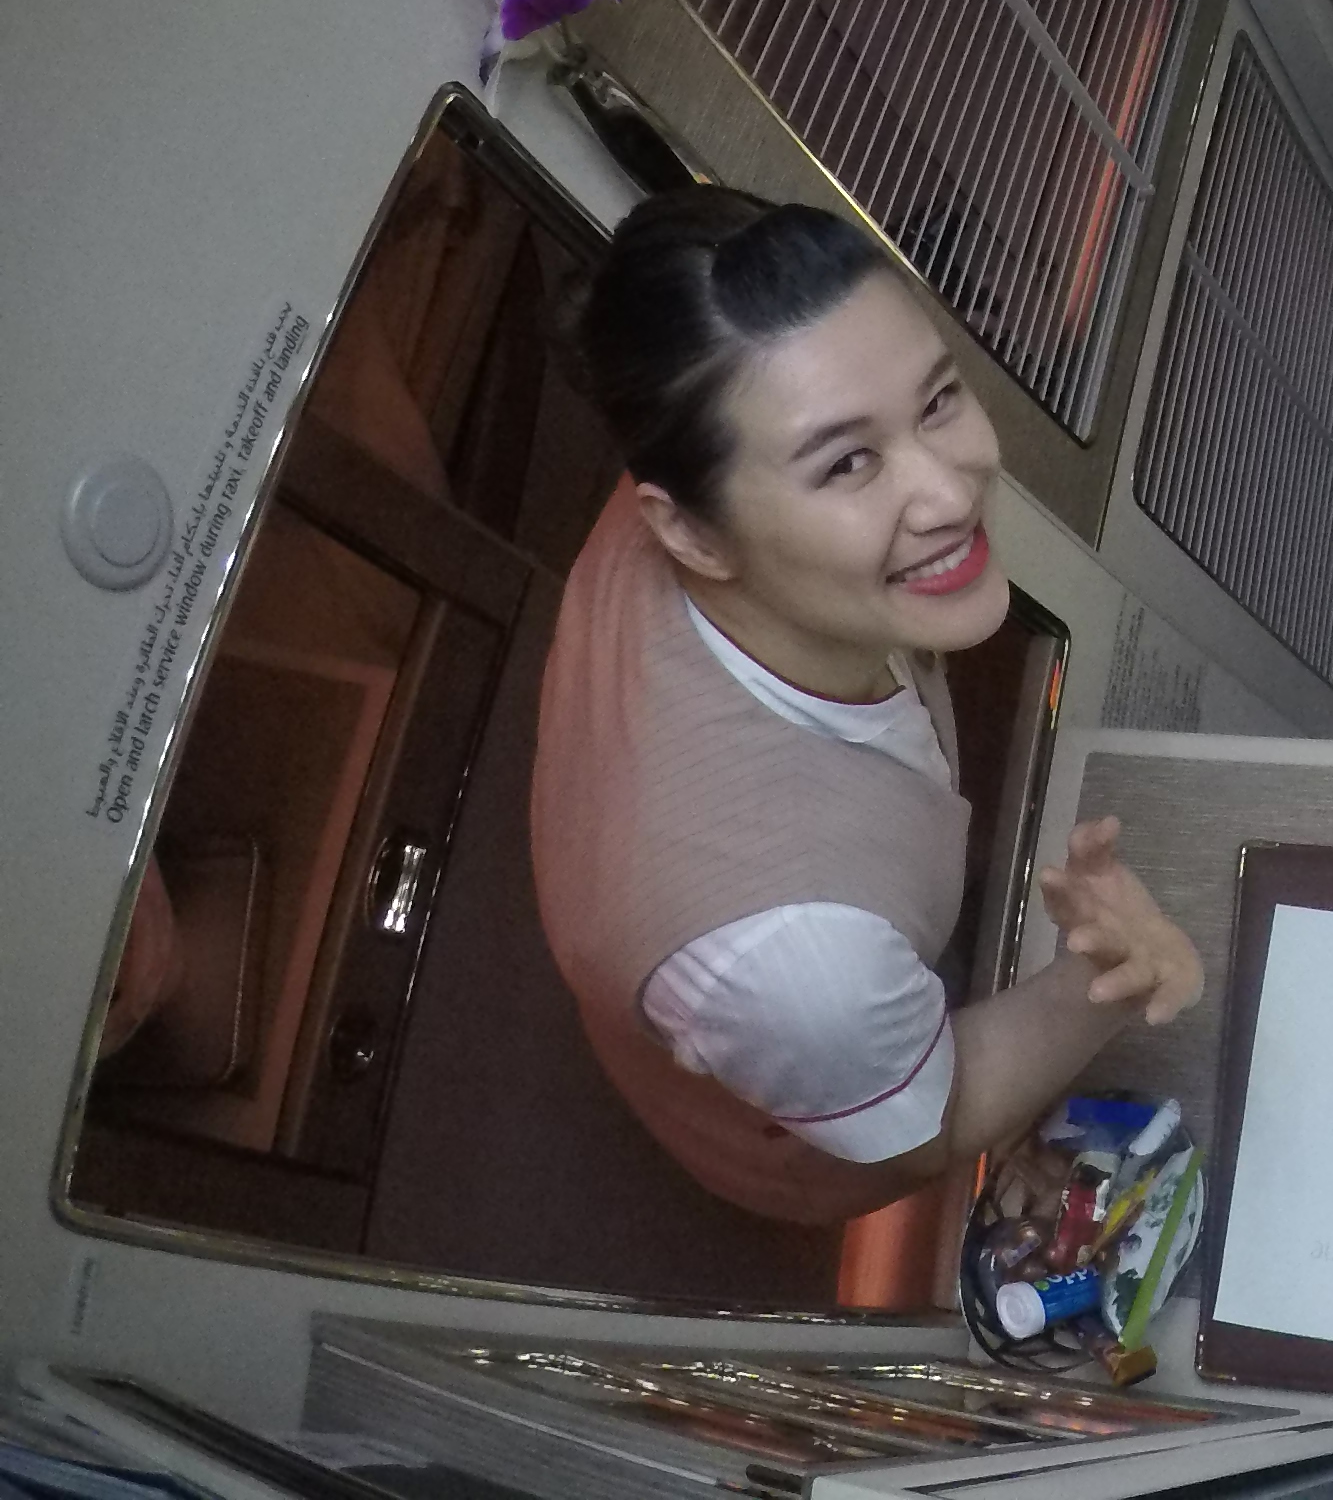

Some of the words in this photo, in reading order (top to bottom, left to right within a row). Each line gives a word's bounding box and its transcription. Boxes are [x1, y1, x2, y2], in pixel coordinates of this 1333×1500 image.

[273, 315, 310, 371] landing
[263, 369, 282, 403] and
[237, 398, 268, 461] takeoff
[200, 503, 232, 558] during
[174, 560, 207, 626] window
[152, 628, 181, 688] service
[133, 692, 161, 737] latch
[125, 736, 145, 772] and
[106, 774, 133, 823] Open
